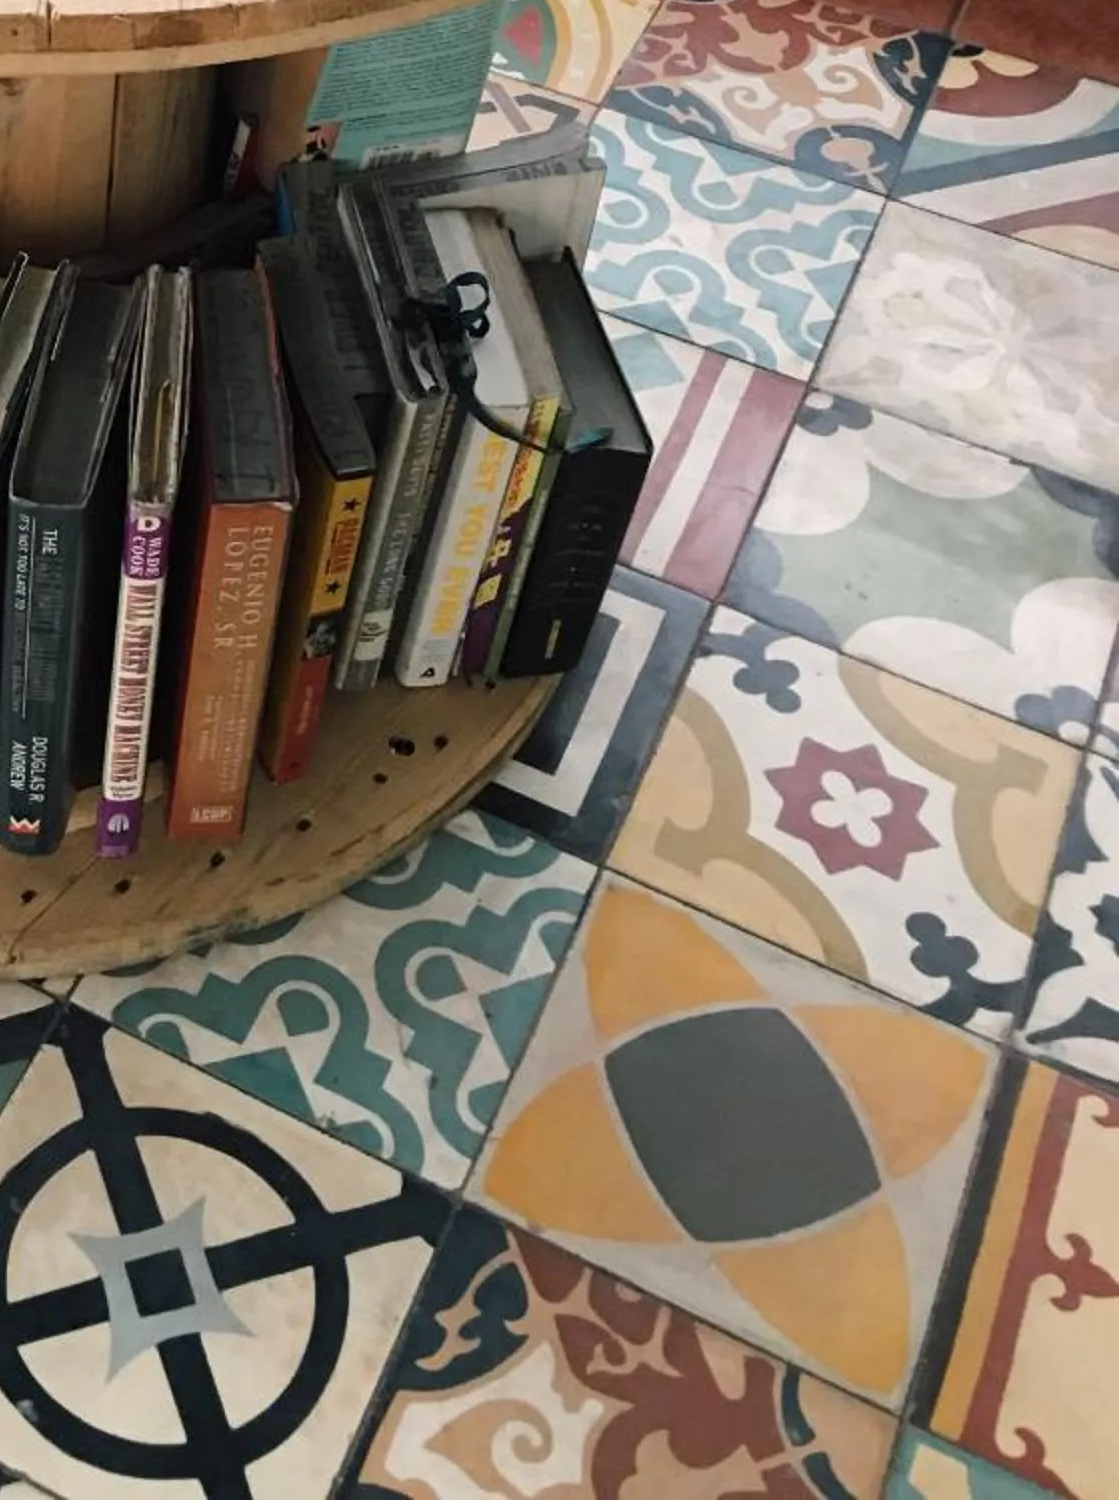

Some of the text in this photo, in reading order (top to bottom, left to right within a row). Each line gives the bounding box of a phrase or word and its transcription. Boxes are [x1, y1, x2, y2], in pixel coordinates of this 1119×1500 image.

[474, 430, 508, 492] EST
[16, 534, 29, 553] NOT
[42, 528, 59, 555] THE
[453, 504, 489, 557] YOU
[16, 555, 28, 573] TOO
[129, 535, 146, 576] COOK
[146, 536, 163, 577] WADE
[241, 526, 273, 626] EUGENIO
[15, 574, 27, 597] LATE
[126, 584, 158, 621] WALL
[432, 565, 468, 633] EVER
[120, 624, 153, 674] STREET
[115, 677, 148, 721] MONEY
[10, 740, 28, 792] ANDREW
[30, 736, 49, 792] DOUGLAS
[109, 723, 143, 785] MACHINE
